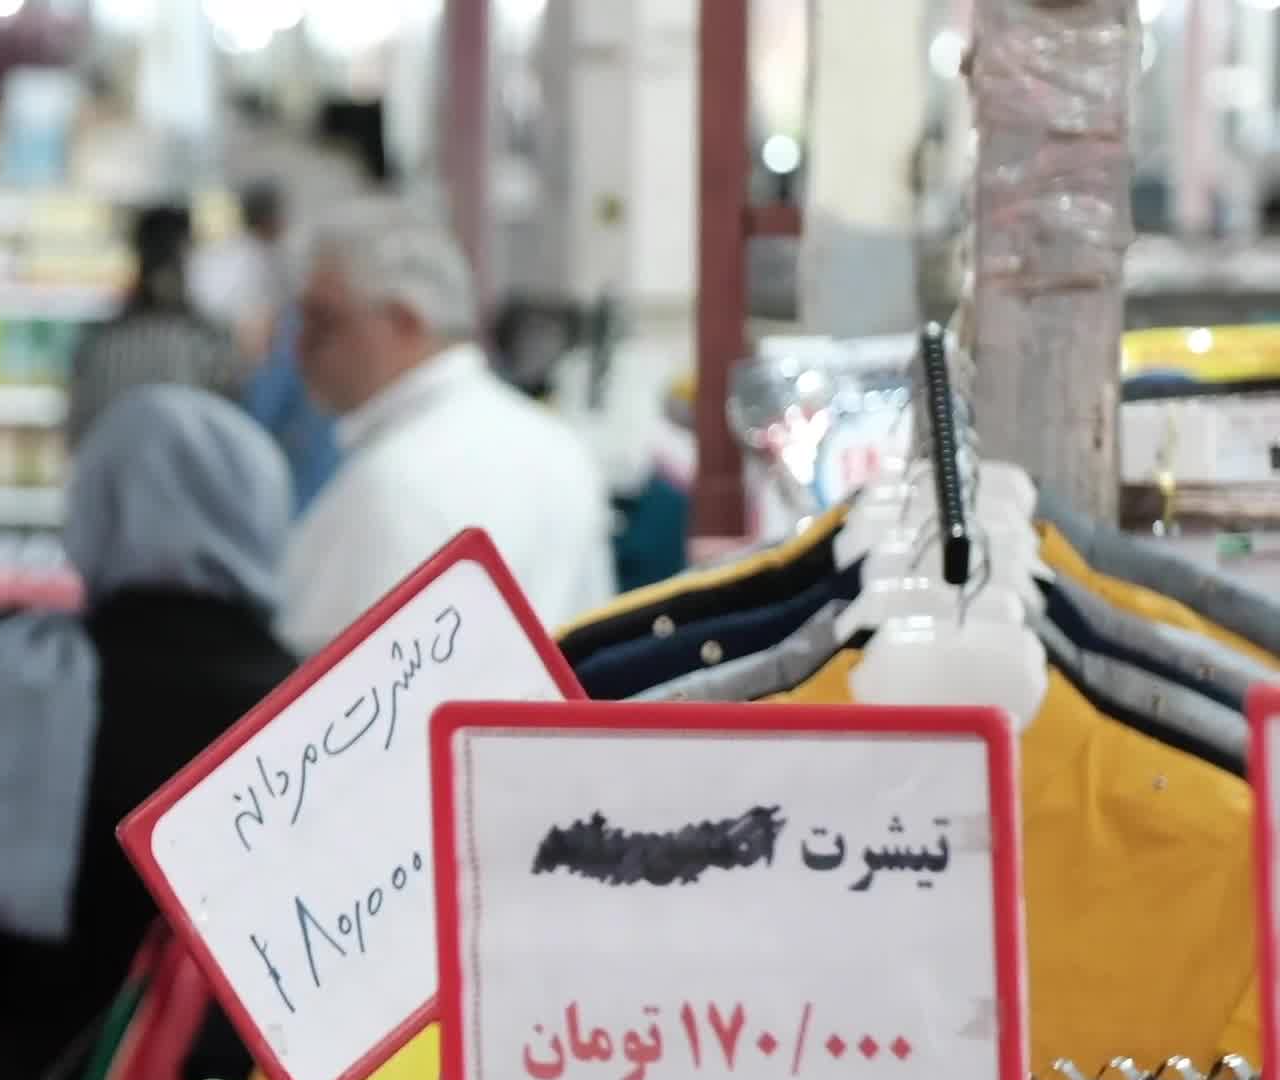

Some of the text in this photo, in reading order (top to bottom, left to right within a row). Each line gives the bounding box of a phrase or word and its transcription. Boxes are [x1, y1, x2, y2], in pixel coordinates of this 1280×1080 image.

[233, 743, 318, 852] مردانه
[801, 815, 950, 892] تیشرت
[680, 1000, 913, 1076] ۱۷۰/۰۰۰
